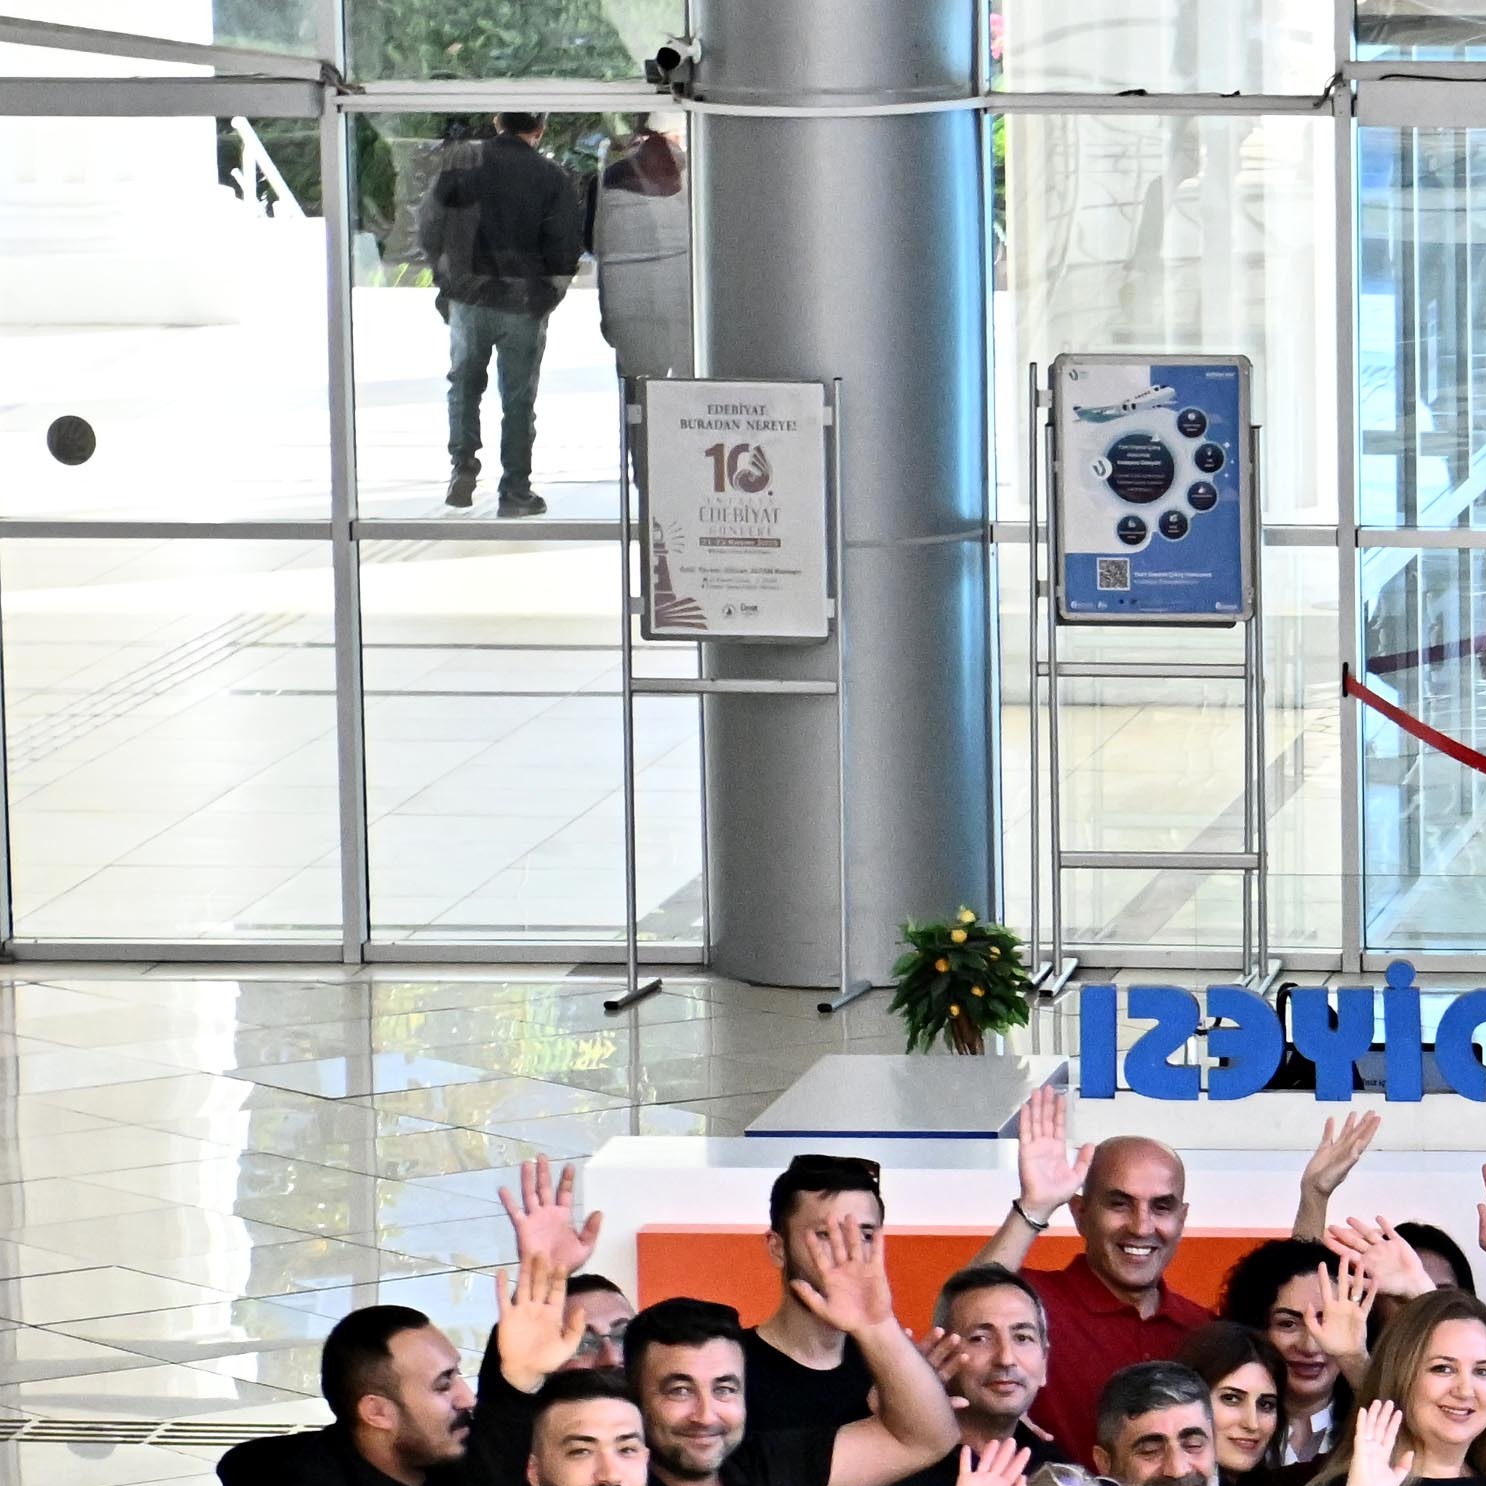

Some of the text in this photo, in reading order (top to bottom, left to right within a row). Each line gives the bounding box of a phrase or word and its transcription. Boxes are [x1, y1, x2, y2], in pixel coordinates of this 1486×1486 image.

[707, 403, 767, 416] EDEBİYAT
[680, 418, 740, 431] BURADAN
[700, 505, 781, 524] EDEBİYAT
